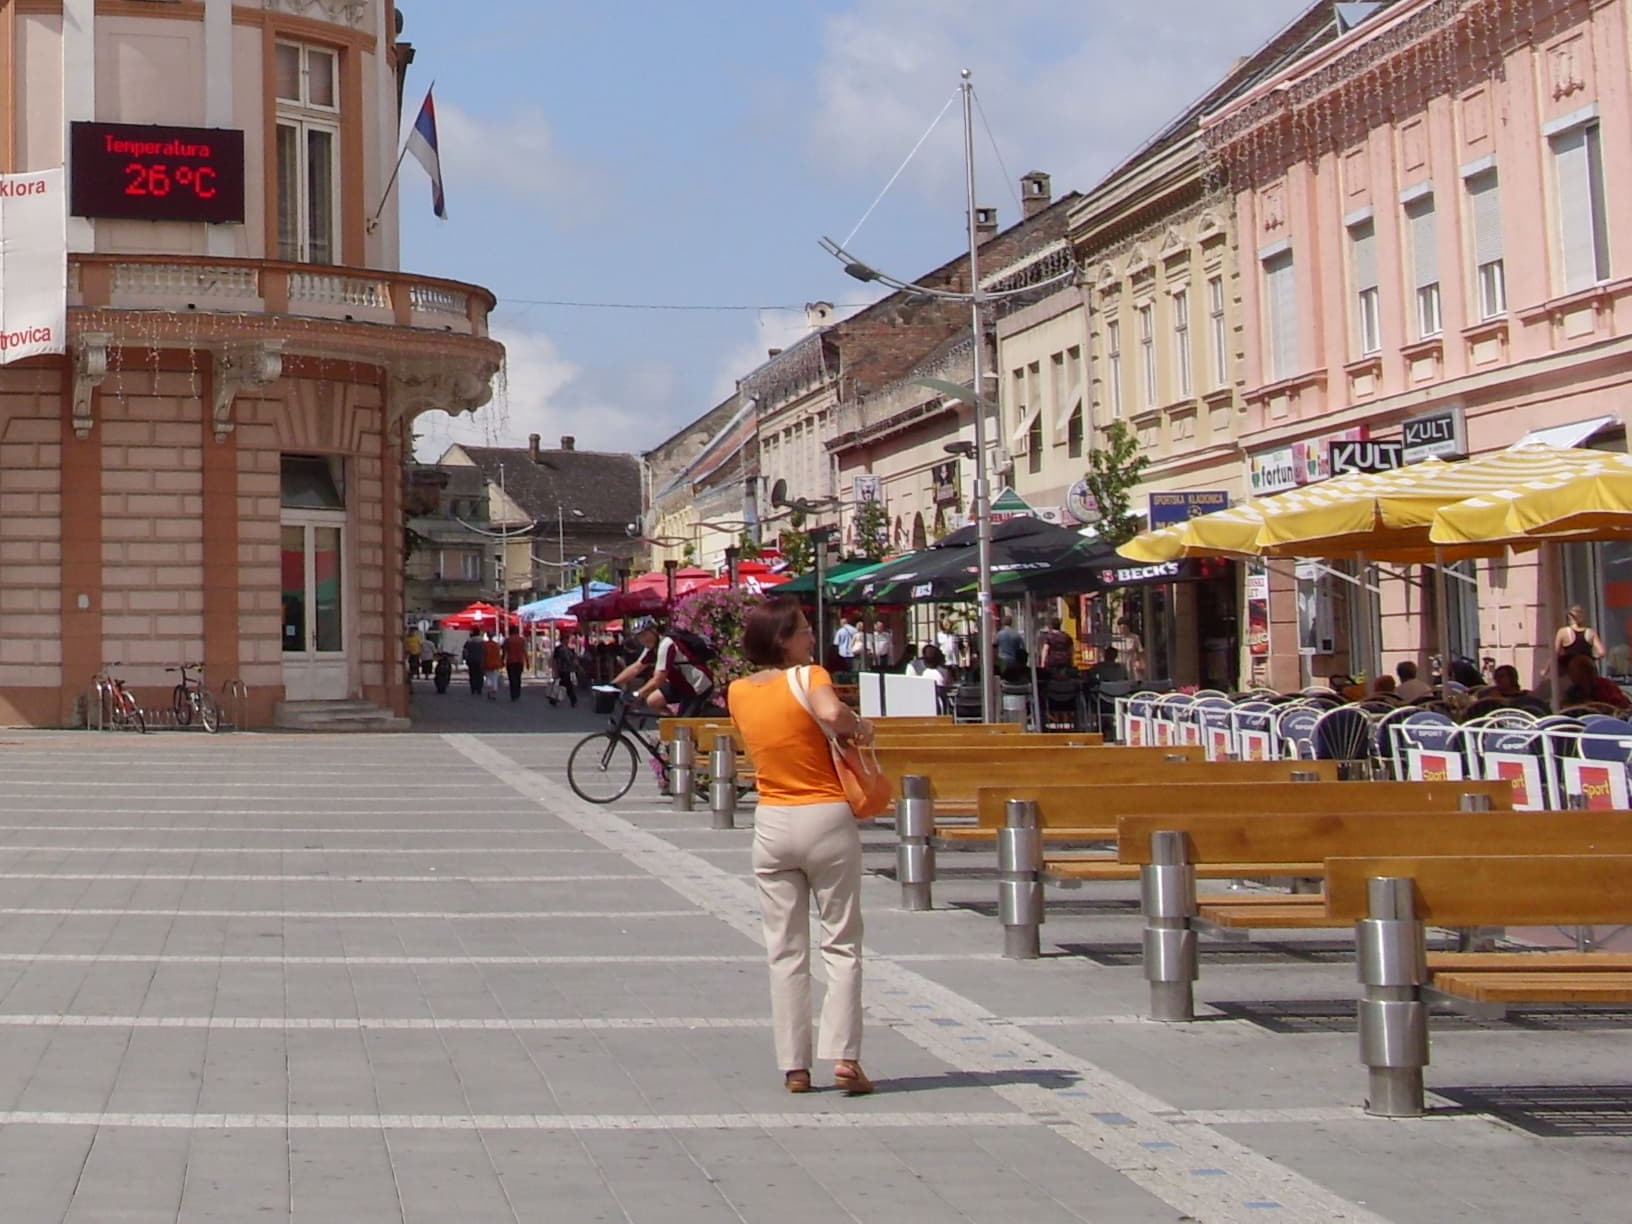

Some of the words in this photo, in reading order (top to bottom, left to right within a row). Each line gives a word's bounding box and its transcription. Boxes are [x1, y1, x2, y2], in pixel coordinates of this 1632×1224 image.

[1406, 418, 1451, 444] KULT
[1333, 443, 1402, 473] KULT
[1117, 561, 1179, 582] BECK'S
[1583, 781, 1612, 797] Sport
